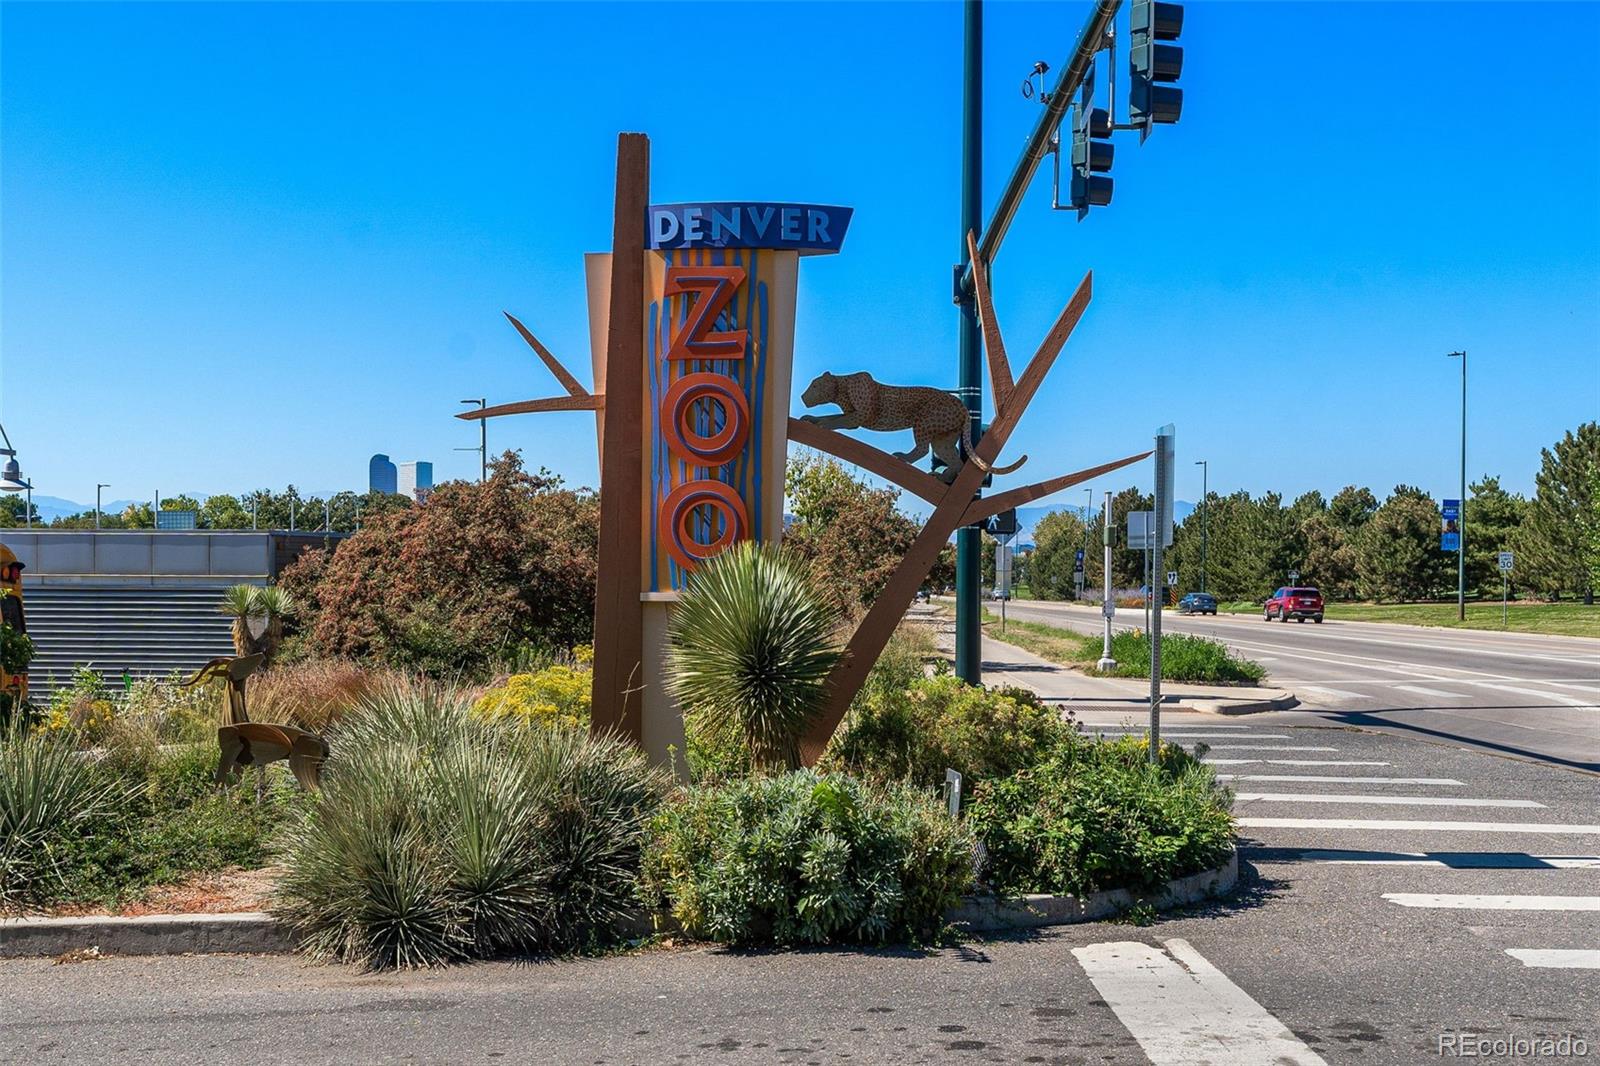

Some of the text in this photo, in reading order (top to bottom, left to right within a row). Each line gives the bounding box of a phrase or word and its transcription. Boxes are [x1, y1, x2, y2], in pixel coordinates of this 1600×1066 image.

[653, 206, 832, 243] DENVER
[661, 266, 750, 572] ZOO
[1500, 561, 1513, 569] 30
